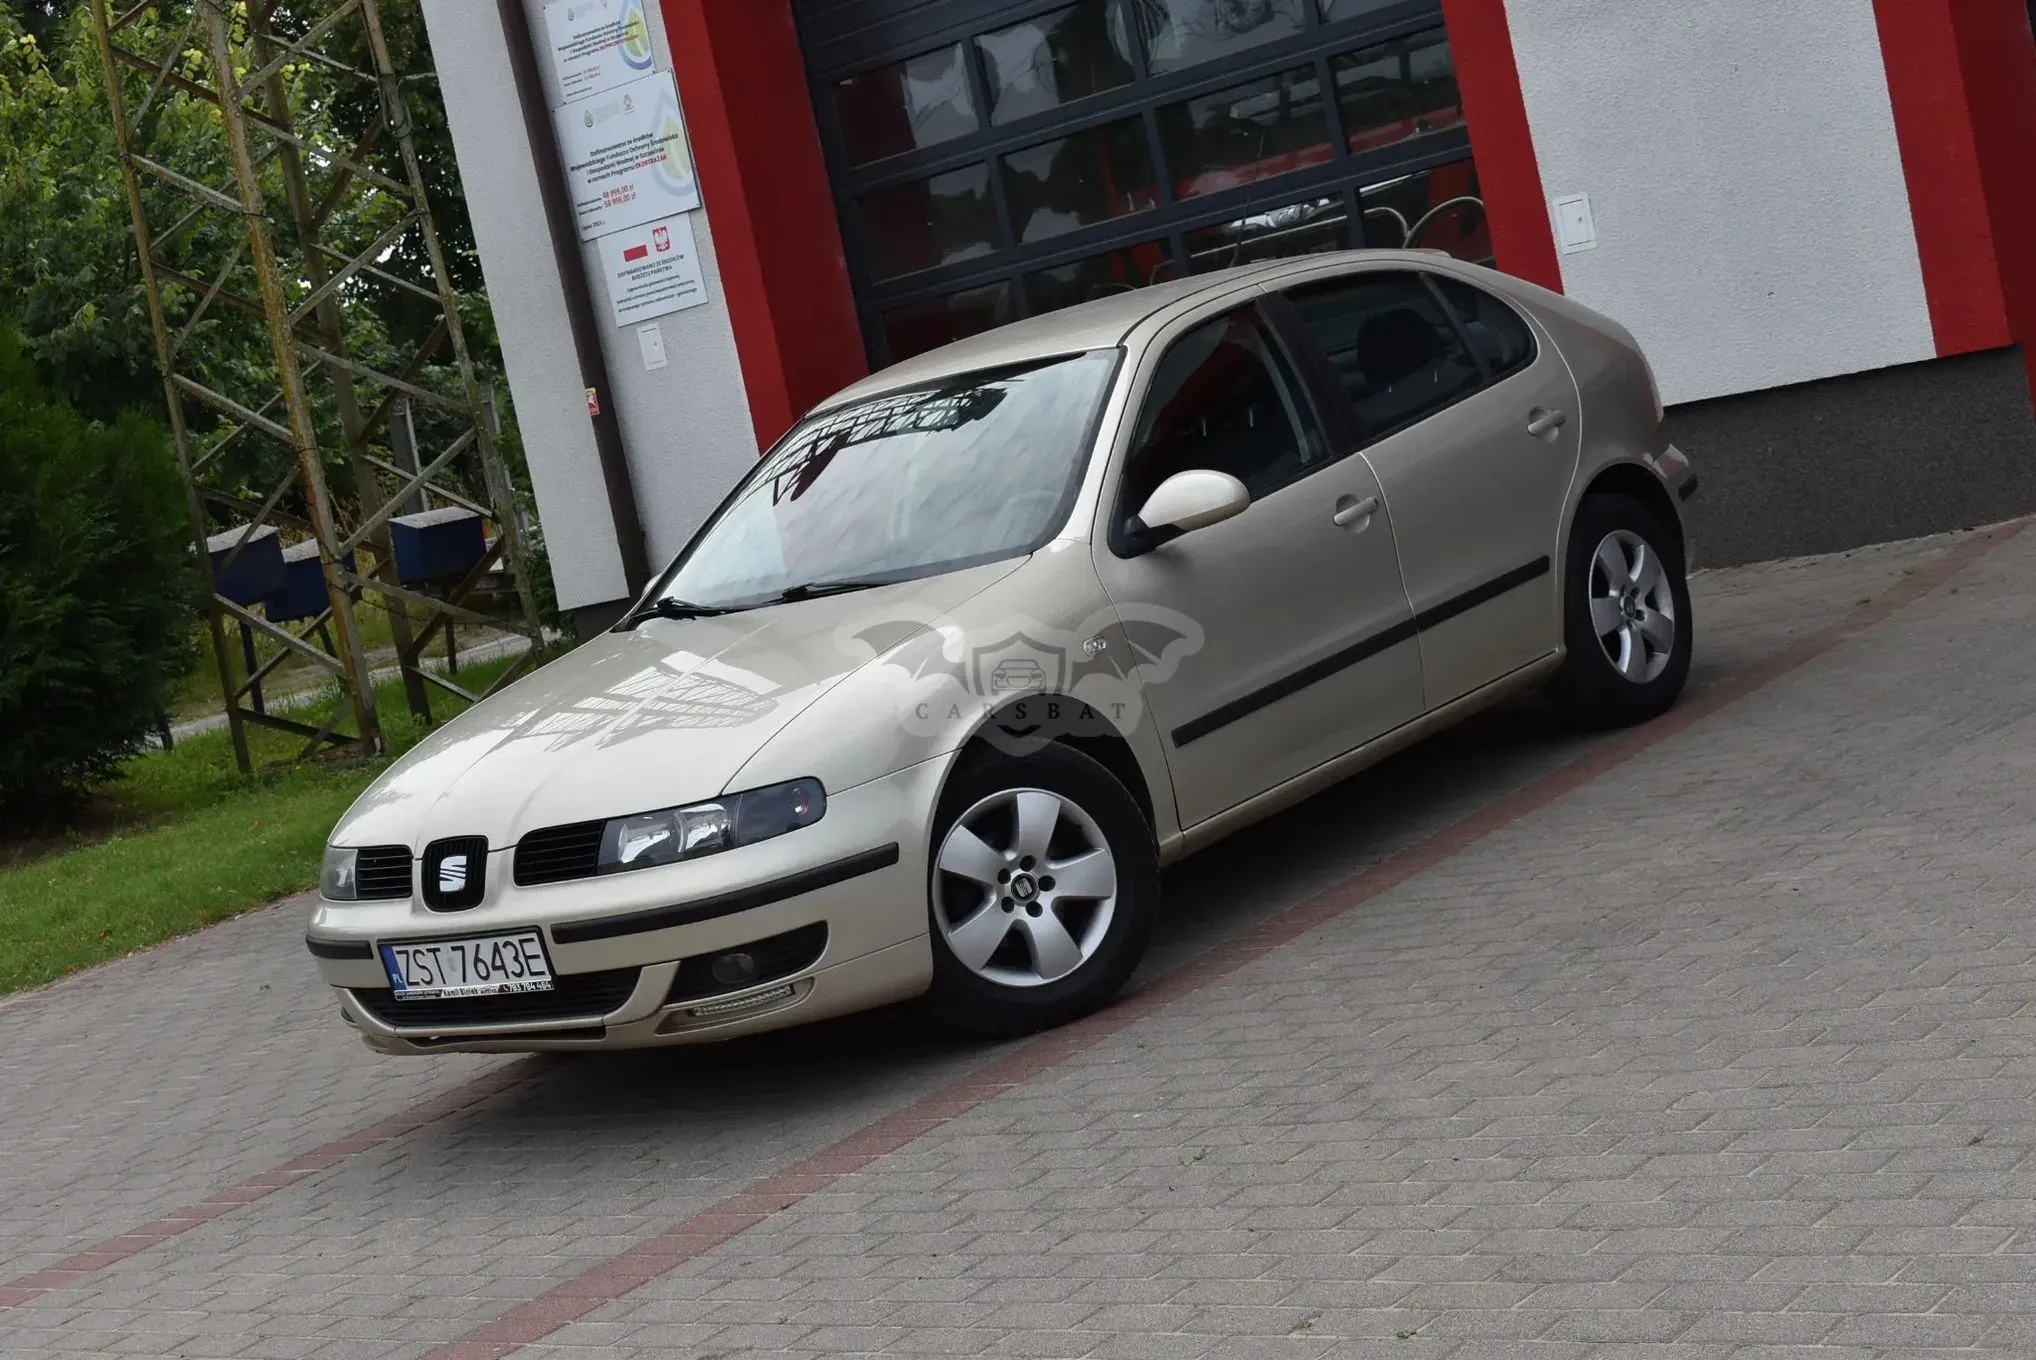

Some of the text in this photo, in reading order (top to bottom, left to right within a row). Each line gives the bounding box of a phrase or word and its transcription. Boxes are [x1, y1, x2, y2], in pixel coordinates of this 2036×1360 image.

[396, 937, 546, 986] ZST 7643E
[393, 973, 403, 984] PL
